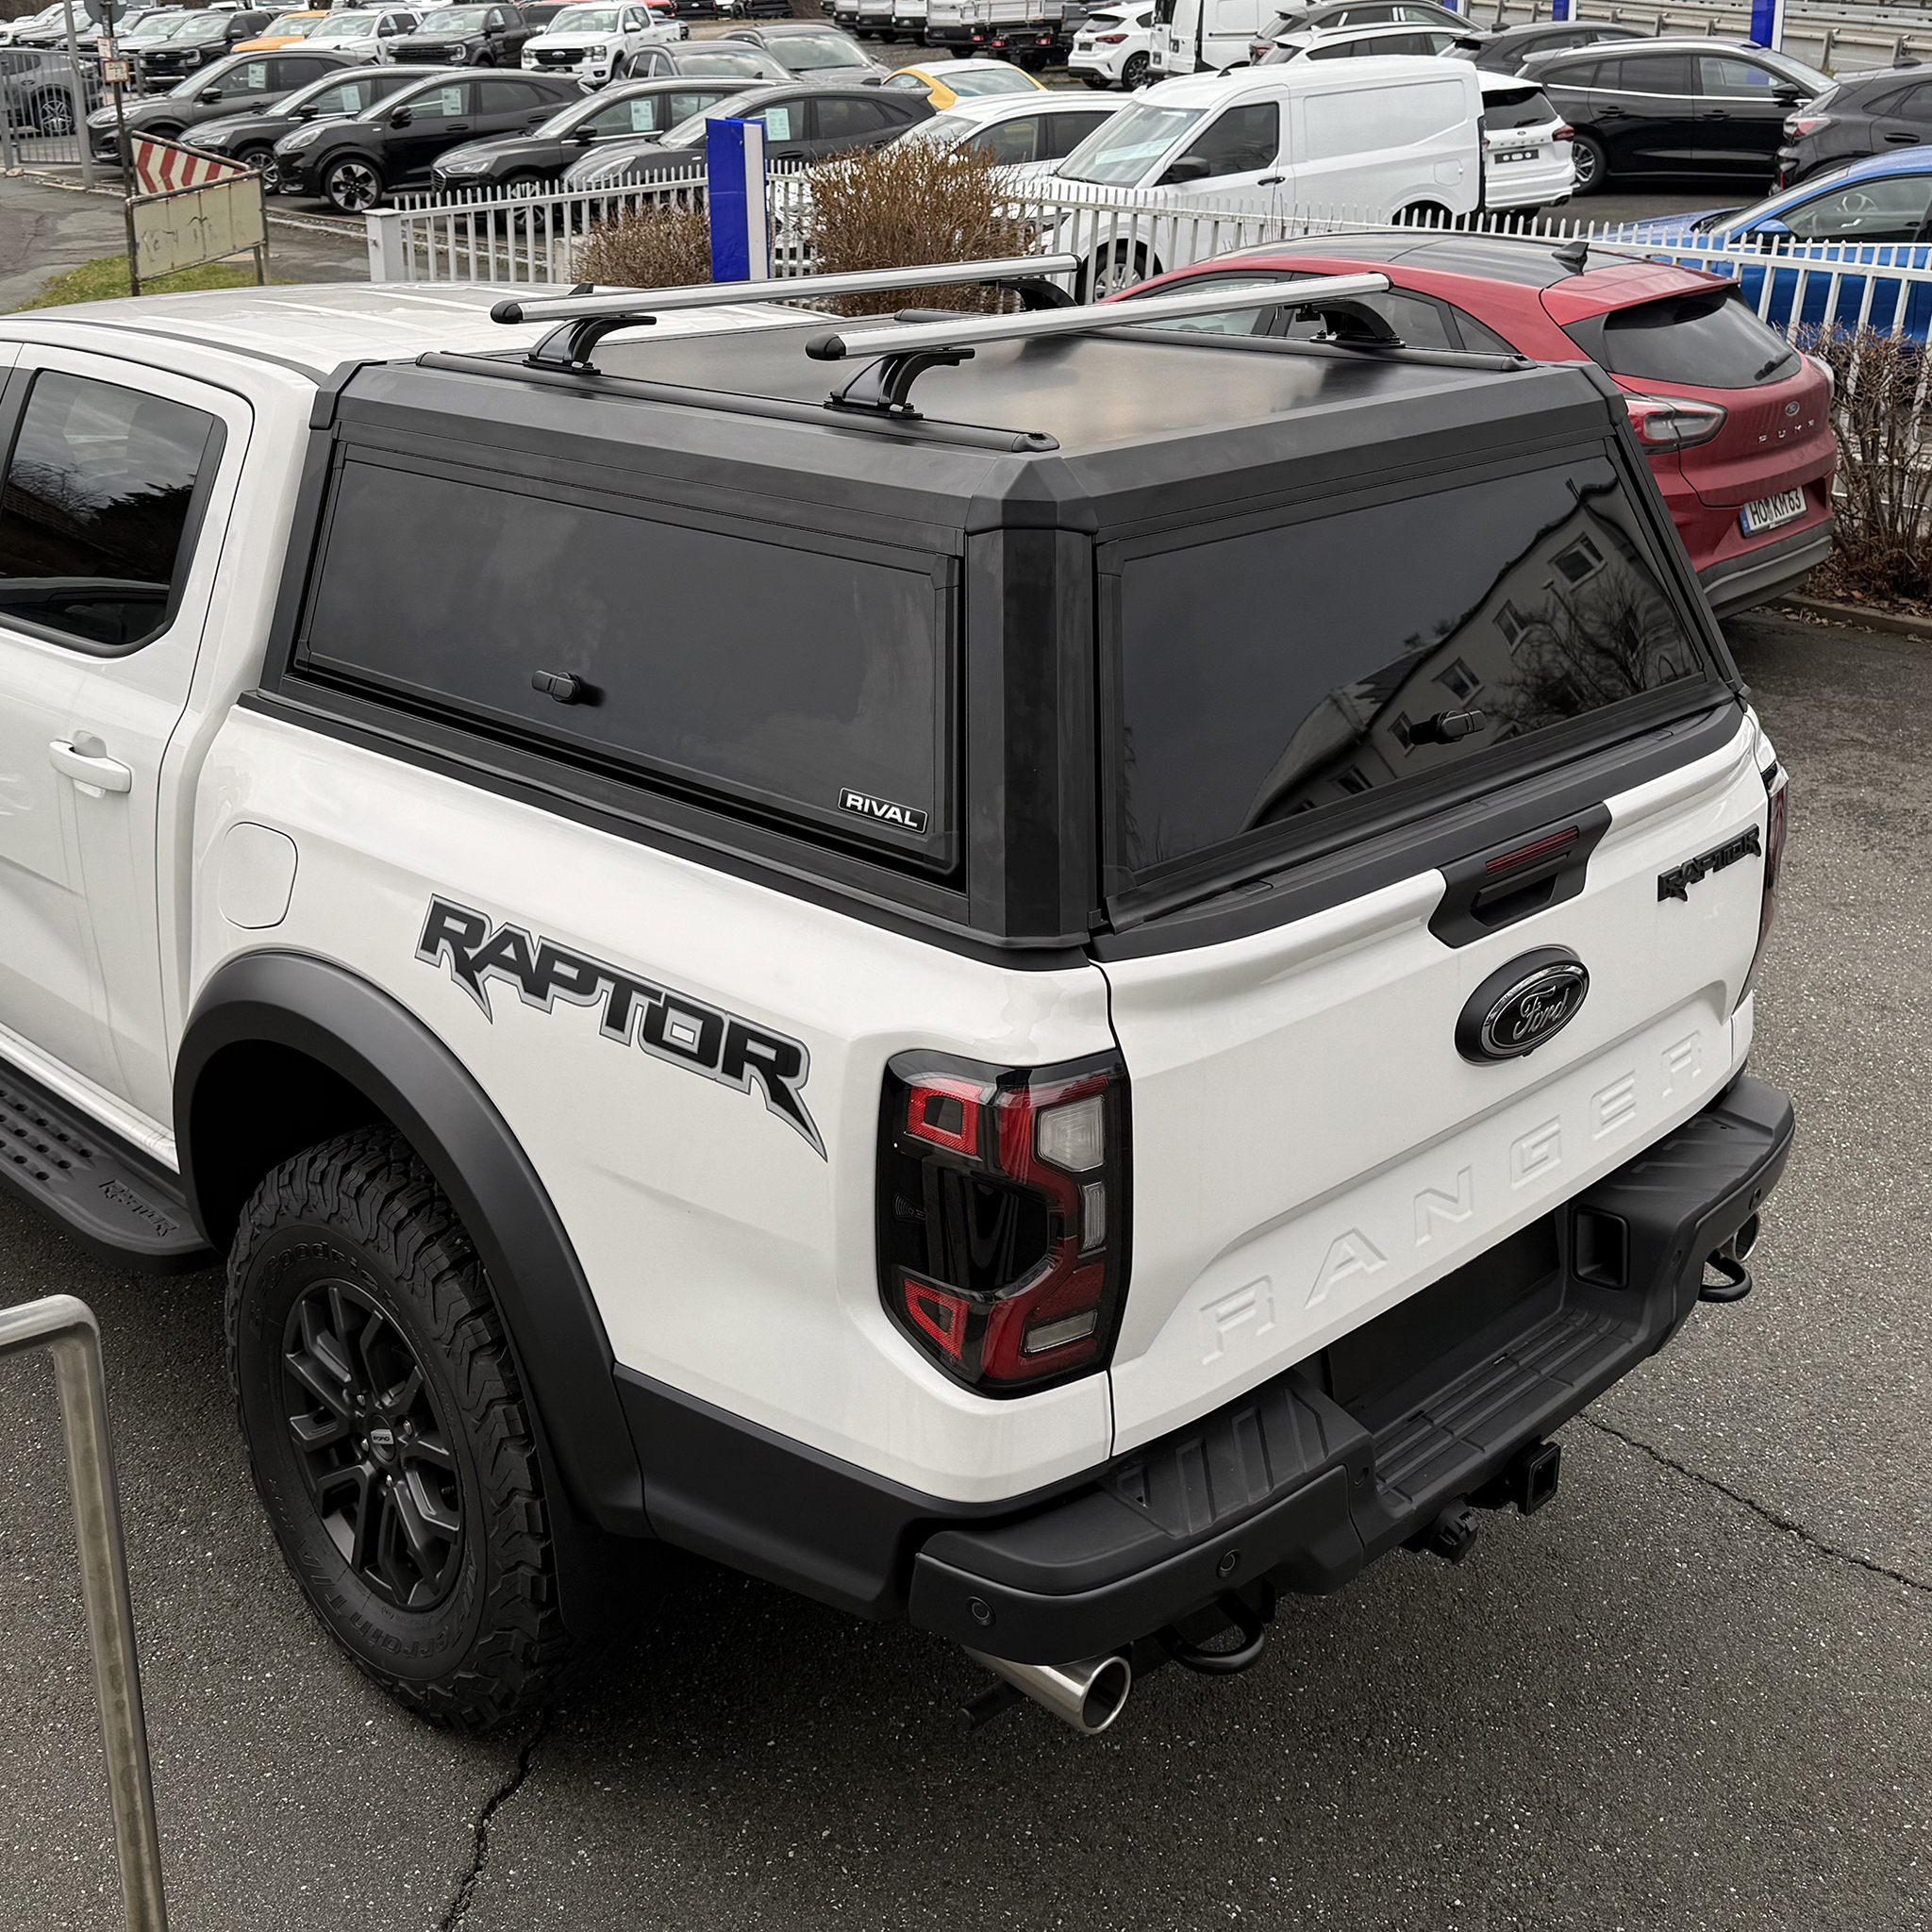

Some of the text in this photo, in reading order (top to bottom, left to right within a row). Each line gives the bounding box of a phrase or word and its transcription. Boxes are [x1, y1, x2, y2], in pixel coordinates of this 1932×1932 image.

[1749, 500, 1767, 525] HO
[845, 792, 918, 827] RIVAL
[1657, 823, 1761, 902] RAPTOR
[415, 892, 827, 1163] RAPTOR
[1512, 984, 1571, 1040] Ford
[1199, 1030, 1702, 1365] RANGER
